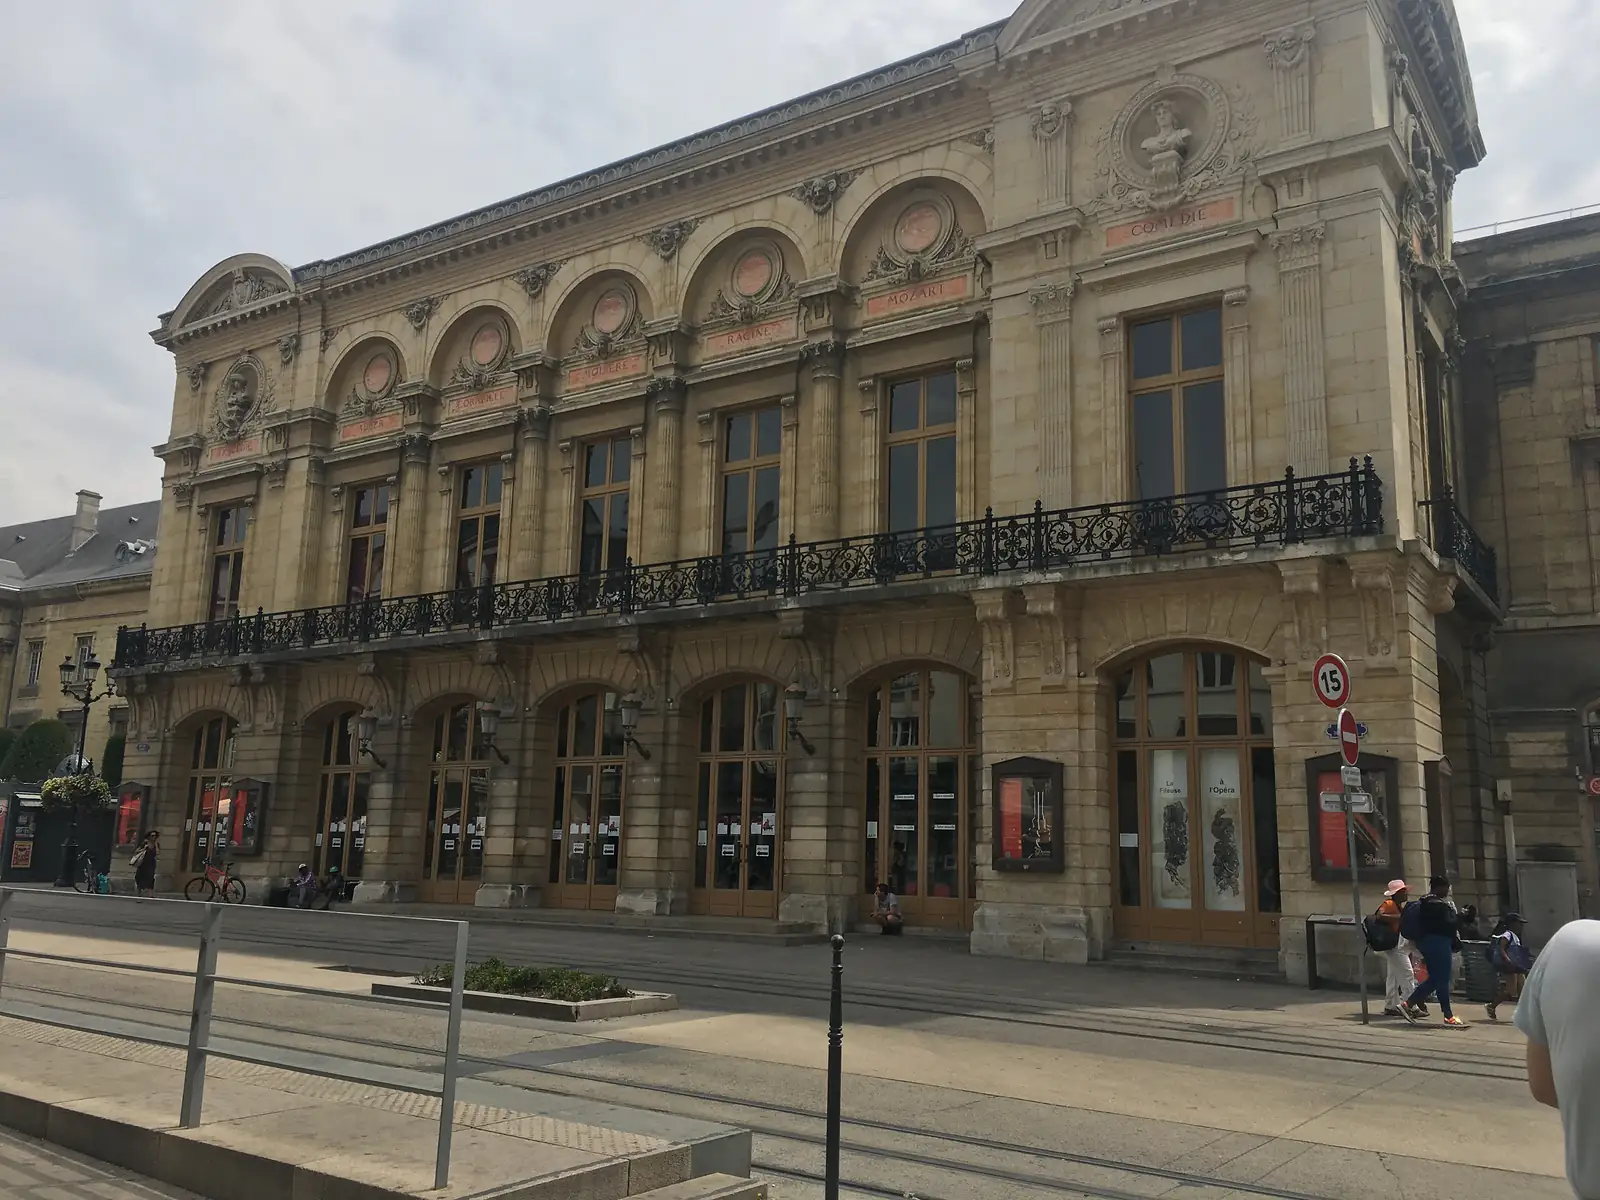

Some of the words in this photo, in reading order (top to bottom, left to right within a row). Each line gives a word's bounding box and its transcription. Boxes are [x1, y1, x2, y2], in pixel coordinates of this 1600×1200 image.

[887, 284, 945, 305] MOZART
[727, 327, 771, 345] RACINE
[585, 360, 629, 377] MOLERE
[1321, 670, 1341, 693] 15
[1209, 787, 1235, 795] l'Opéra
